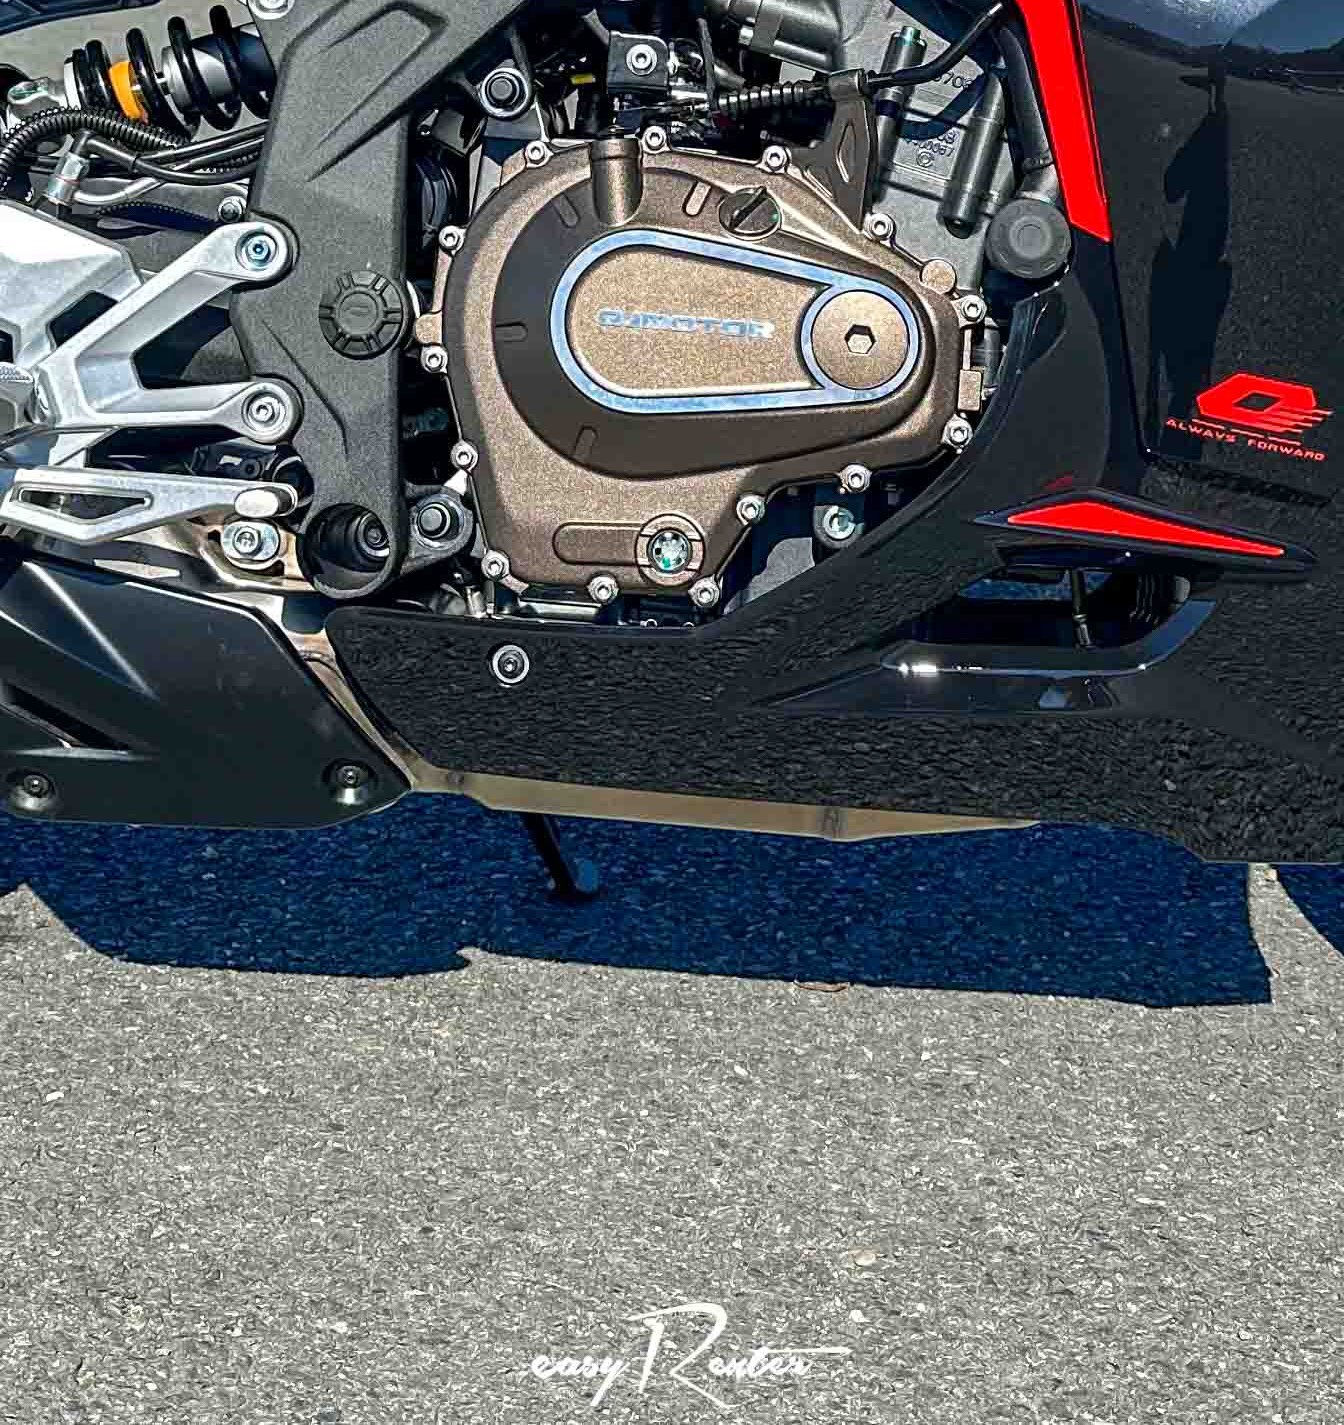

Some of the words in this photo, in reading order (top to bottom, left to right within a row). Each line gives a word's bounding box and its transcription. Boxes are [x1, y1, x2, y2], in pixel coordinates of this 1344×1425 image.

[596, 308, 775, 341] QJMOTOR
[1166, 416, 1236, 443] ALWAYS
[1247, 439, 1326, 462] FORWARD
